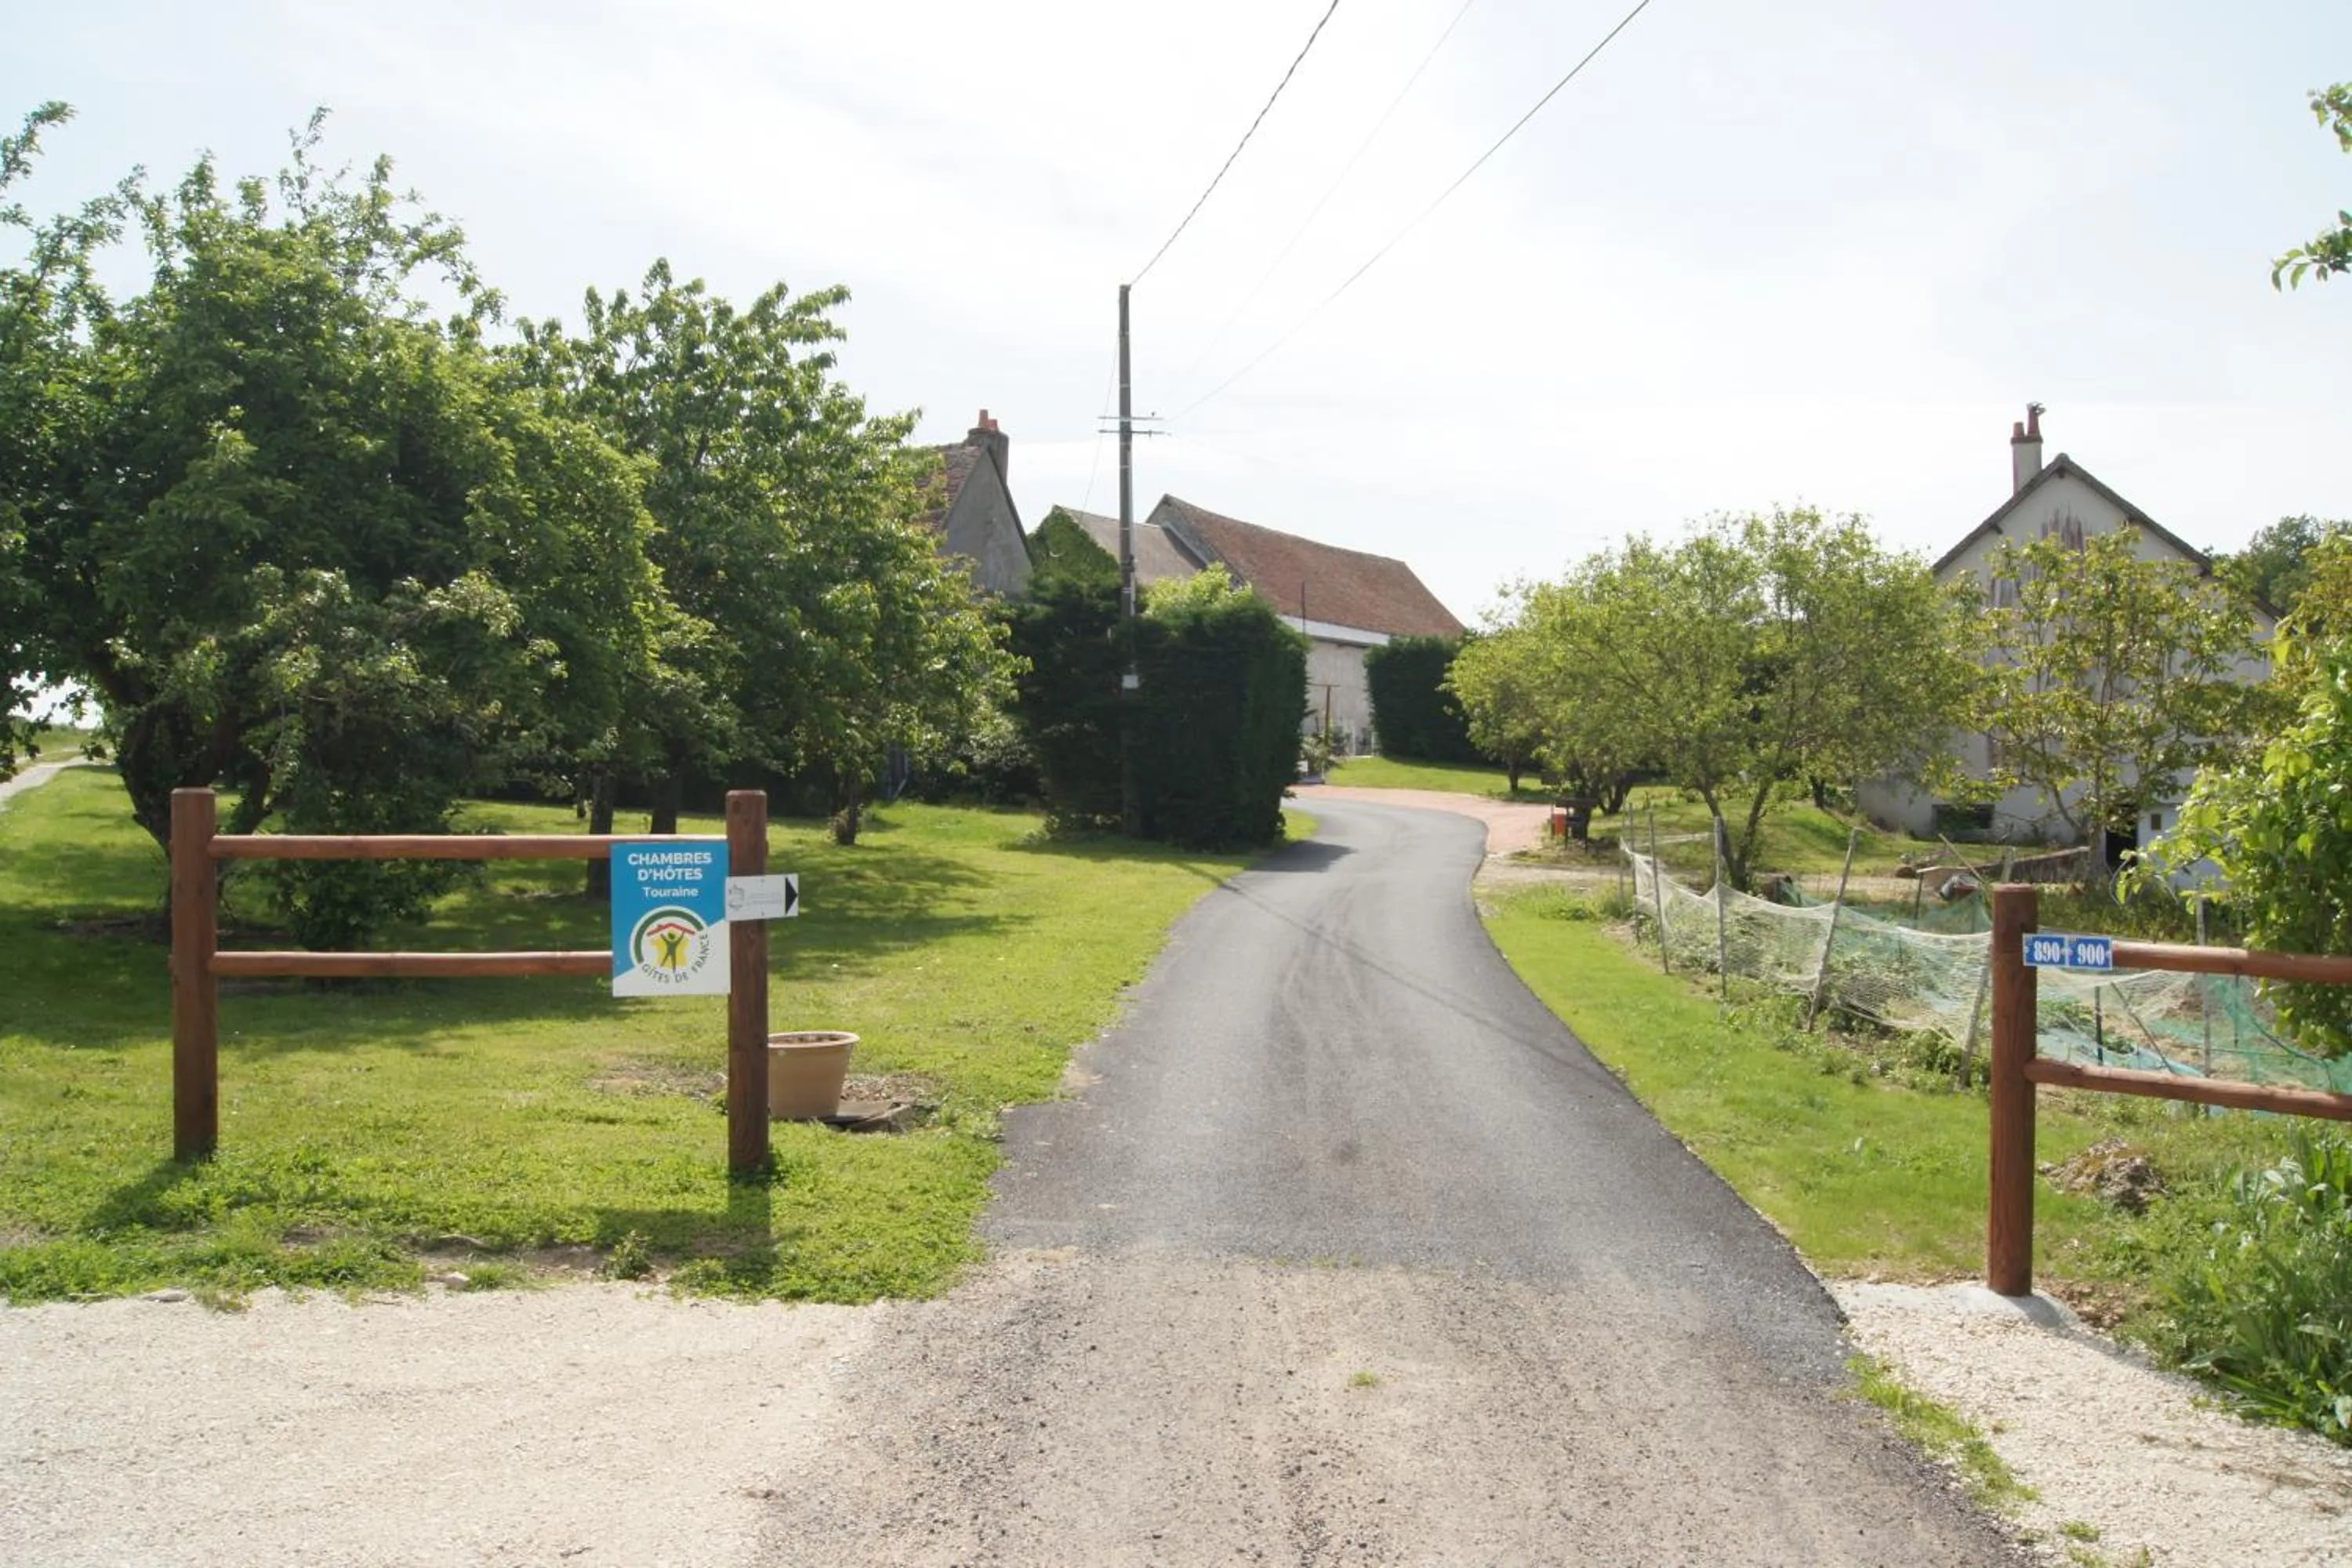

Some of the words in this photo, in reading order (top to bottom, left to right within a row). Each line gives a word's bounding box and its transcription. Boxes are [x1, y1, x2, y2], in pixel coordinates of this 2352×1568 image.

[628, 852, 713, 866] CHAMBRES
[637, 866, 702, 881] D'HÔTES
[642, 887, 699, 898] Touraine
[674, 971, 689, 983] DE
[691, 934, 710, 973] FRANCE
[2034, 941, 2060, 963] 890
[2077, 943, 2105, 966] 900
